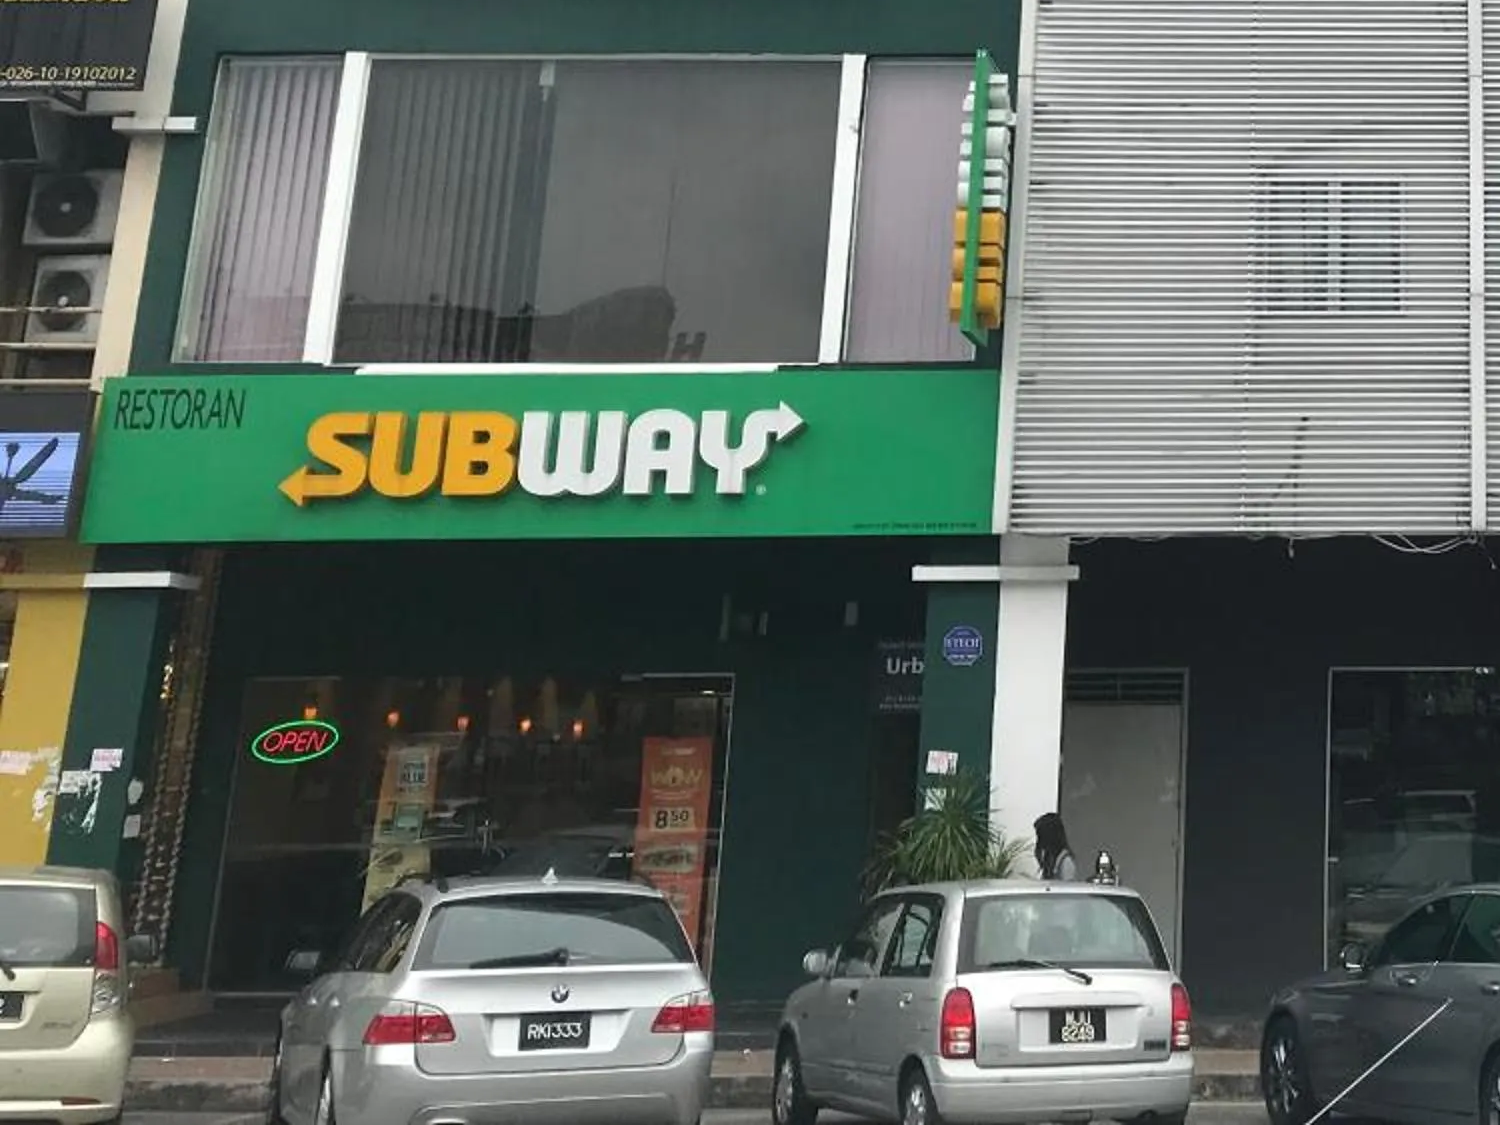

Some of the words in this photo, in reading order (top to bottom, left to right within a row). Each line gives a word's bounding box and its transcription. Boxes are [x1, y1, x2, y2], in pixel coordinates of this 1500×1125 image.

[113, 388, 246, 430] RESTORAN
[278, 399, 805, 507] SUBWAY
[263, 731, 329, 753] OPEN
